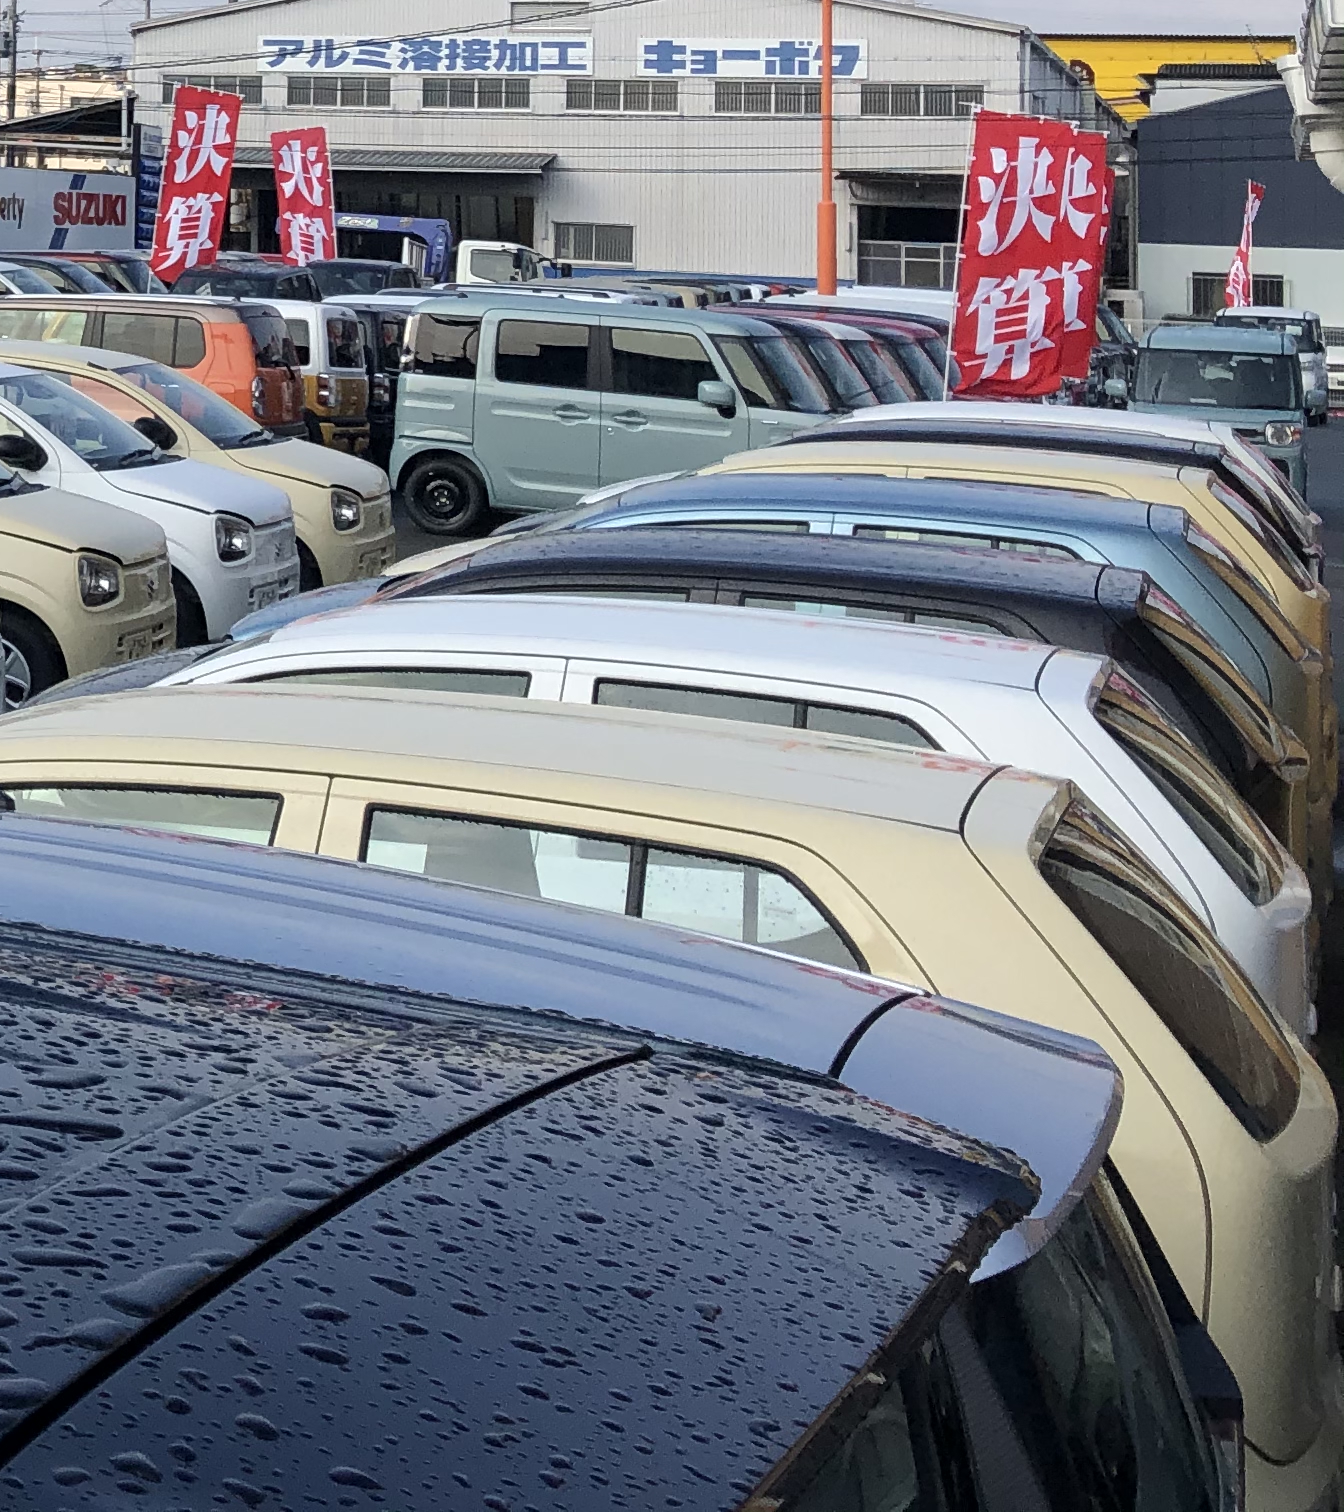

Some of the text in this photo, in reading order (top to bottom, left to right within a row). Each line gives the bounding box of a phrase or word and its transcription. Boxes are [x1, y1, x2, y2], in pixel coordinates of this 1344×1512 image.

[262, 38, 588, 72] アルミ溶接加工
[53, 191, 127, 226] SUZUKI
[155, 104, 232, 272] 決算
[963, 136, 1060, 381] 決算
